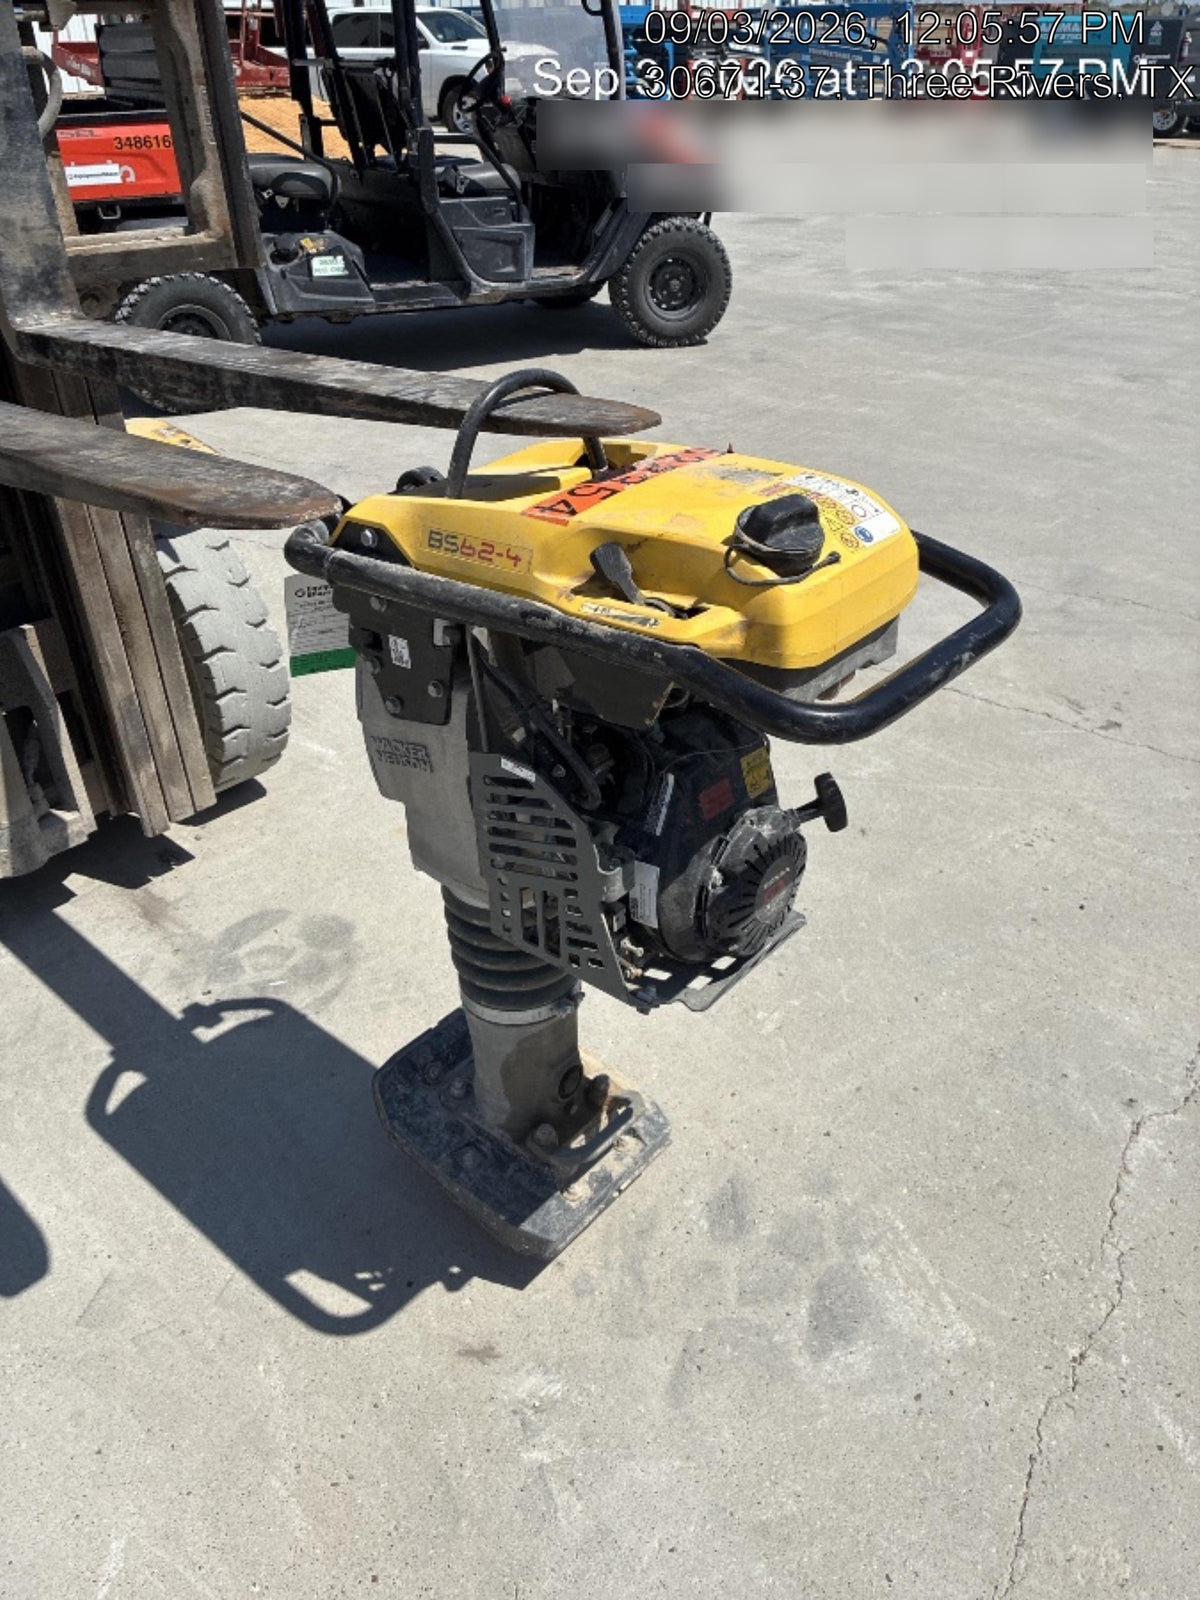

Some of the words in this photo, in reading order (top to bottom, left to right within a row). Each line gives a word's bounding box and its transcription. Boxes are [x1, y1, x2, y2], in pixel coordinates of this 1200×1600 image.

[113, 134, 173, 150] 348616
[428, 529, 522, 567] BS62-4
[370, 735, 430, 760] WACKER
